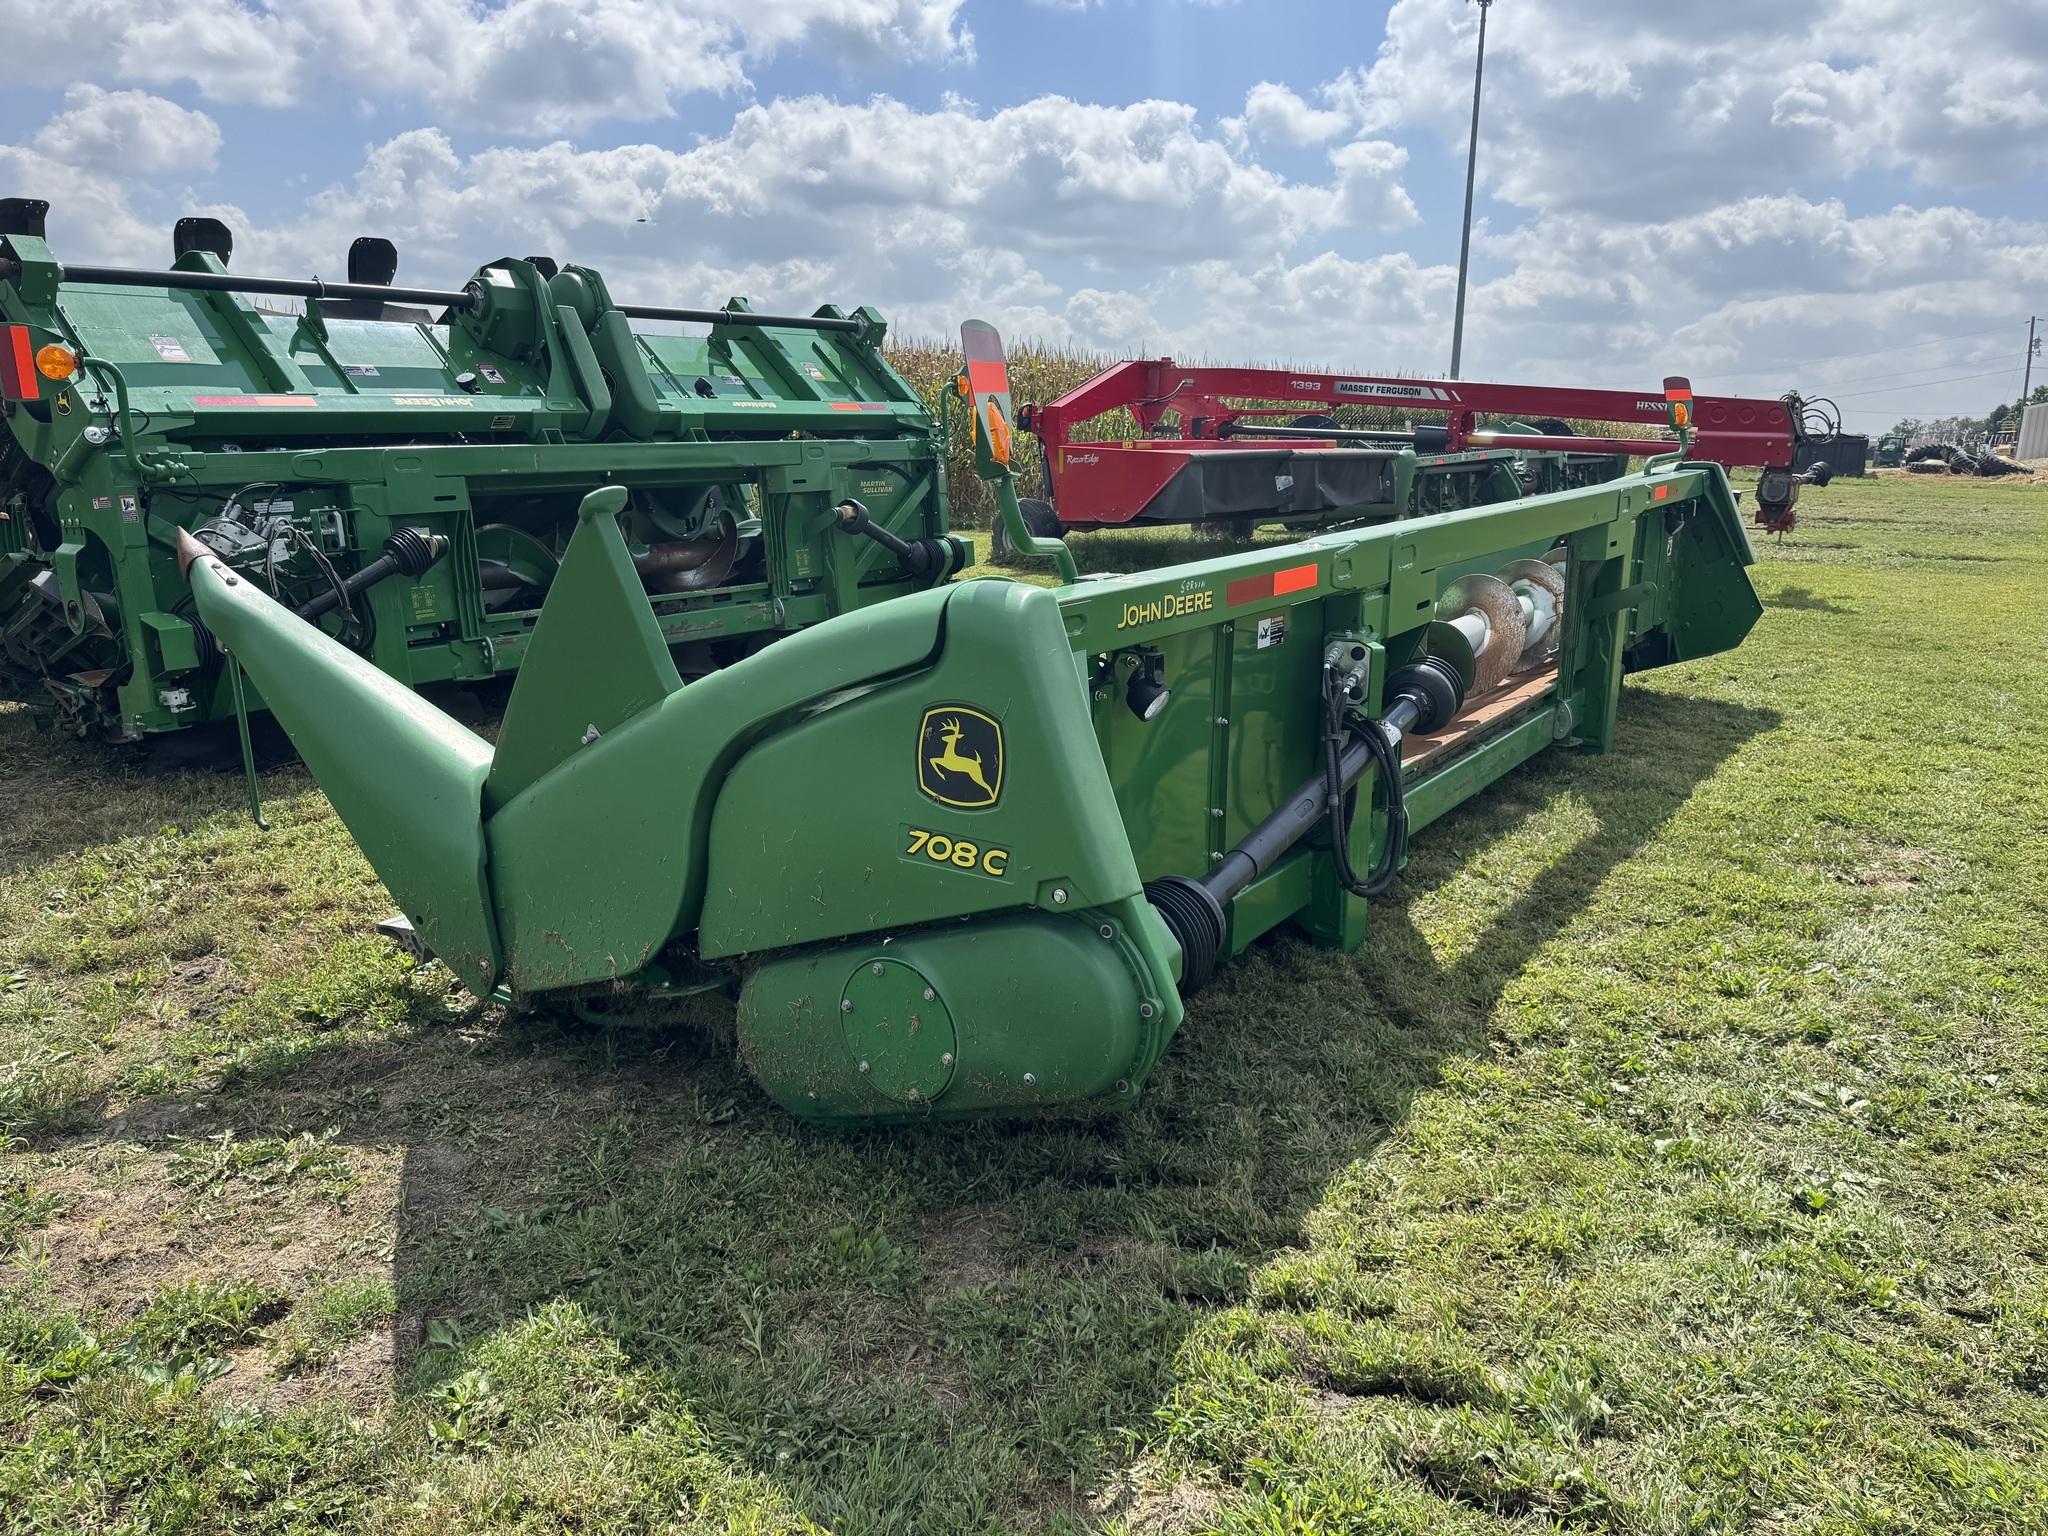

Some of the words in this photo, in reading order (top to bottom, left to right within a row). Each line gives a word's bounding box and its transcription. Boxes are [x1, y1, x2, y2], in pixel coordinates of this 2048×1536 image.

[1290, 380, 1321, 391] 1393
[1340, 383, 1374, 394] MASSEY
[1376, 386, 1421, 396] FERGUSON
[860, 480, 886, 488] MARTIN
[862, 486, 893, 494] SULLIVAN
[1117, 600, 1162, 630] JOHN
[1163, 590, 1213, 619] DEERE
[906, 829, 979, 869] 708
[982, 849, 1009, 877] C
